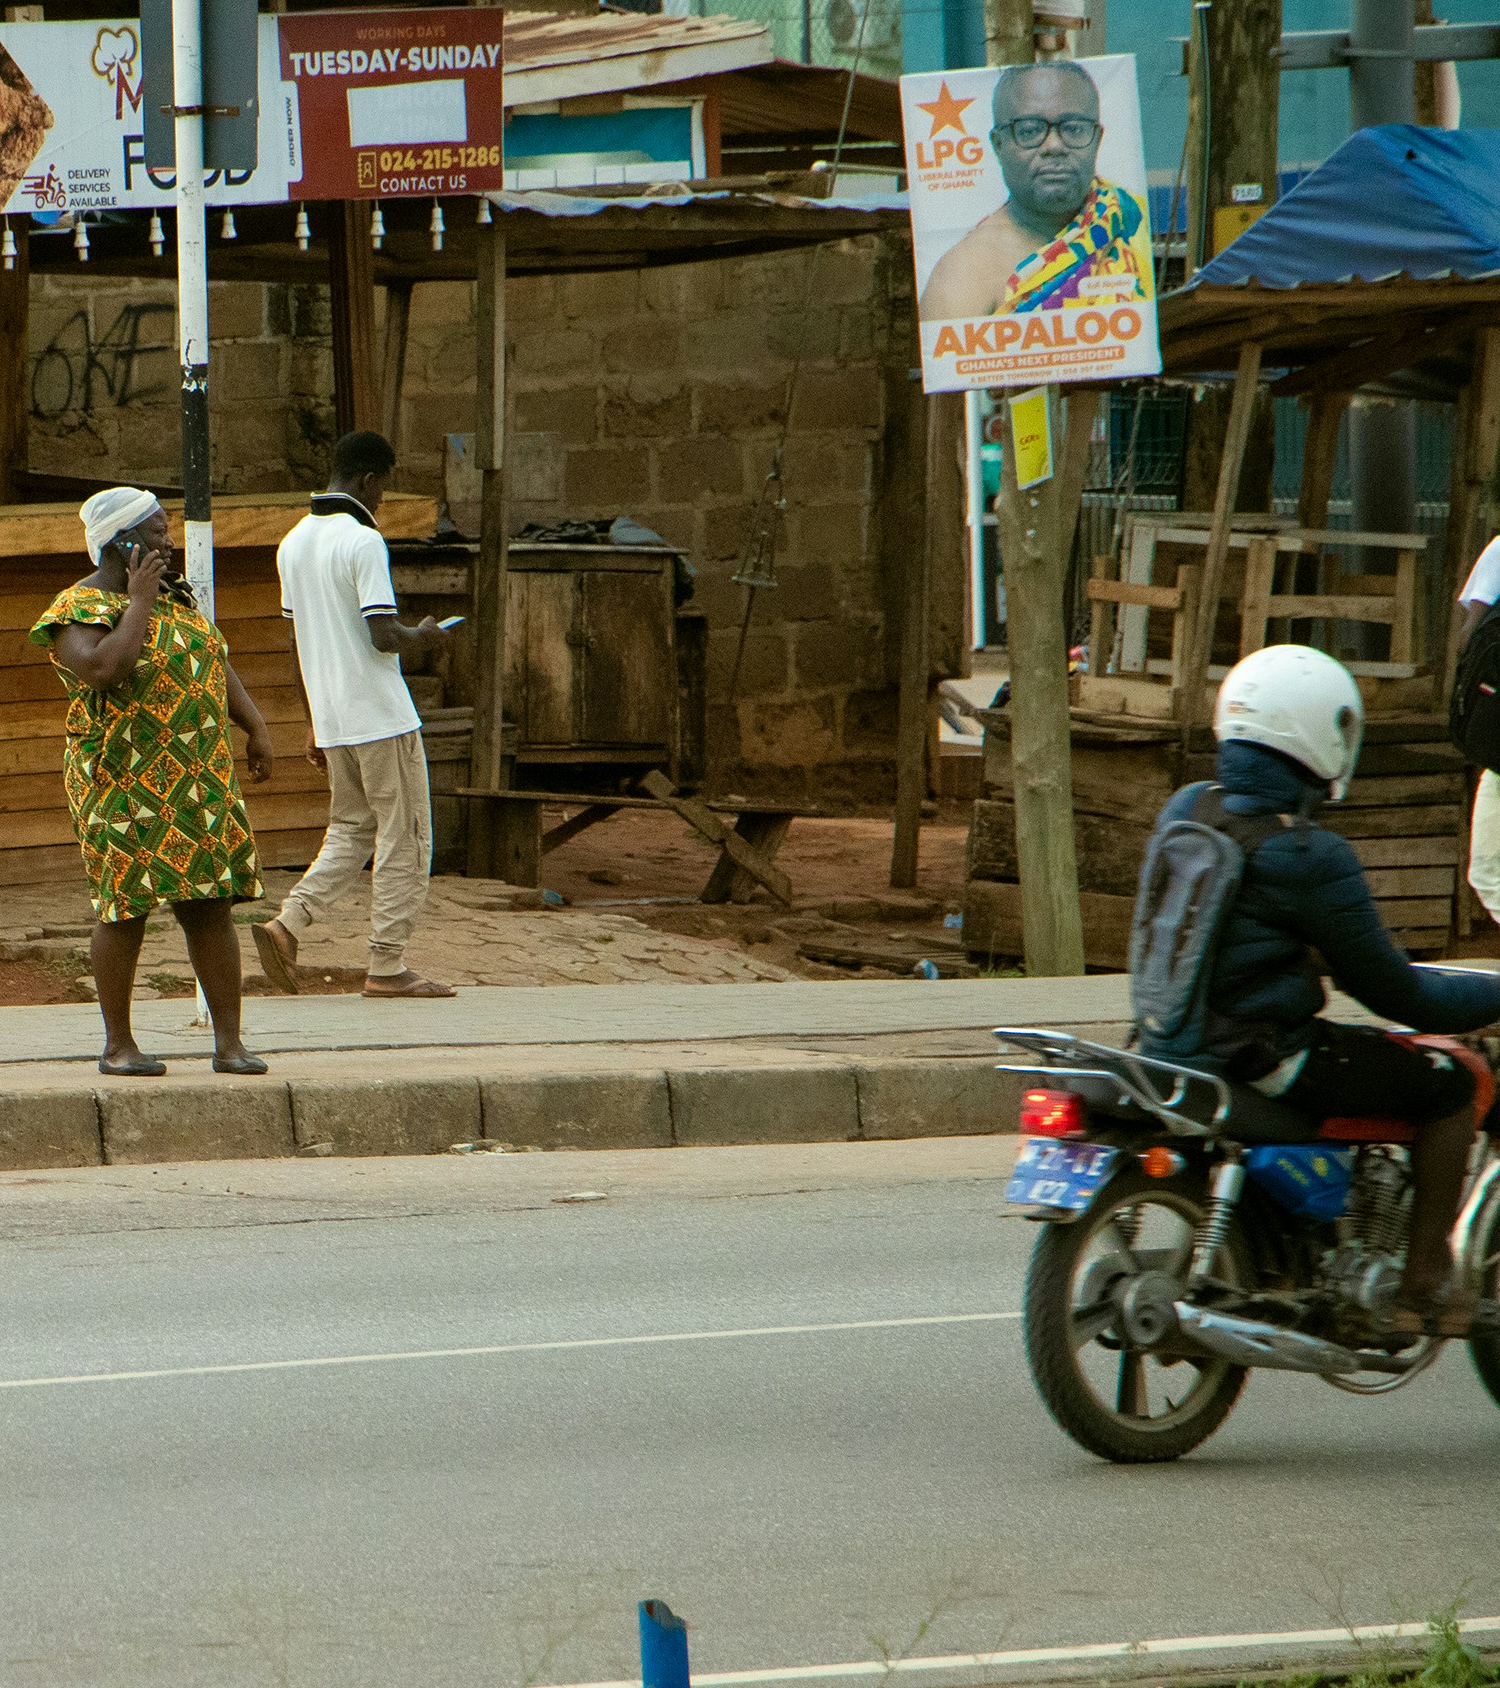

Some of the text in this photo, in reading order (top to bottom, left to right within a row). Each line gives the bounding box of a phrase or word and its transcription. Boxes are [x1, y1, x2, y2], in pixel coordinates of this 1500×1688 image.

[356, 25, 447, 40] WORKING DAYS
[289, 44, 501, 77] TUESDAY-SUNDAY
[285, 96, 296, 167] ORDER NOW
[379, 146, 500, 172] 024-215-1286
[916, 136, 984, 170] LPG
[68, 168, 111, 180] DELIVERY
[380, 174, 467, 193] CONTACT US
[918, 168, 985, 182] LIBERAL PARTY
[68, 183, 111, 194] SERVICES
[928, 180, 975, 192] OF GHANA
[69, 197, 117, 207] AVAILABLE
[932, 308, 1142, 359] AKPALOO
[960, 348, 1121, 372] GHANA'S NEXT PRESIDENT
